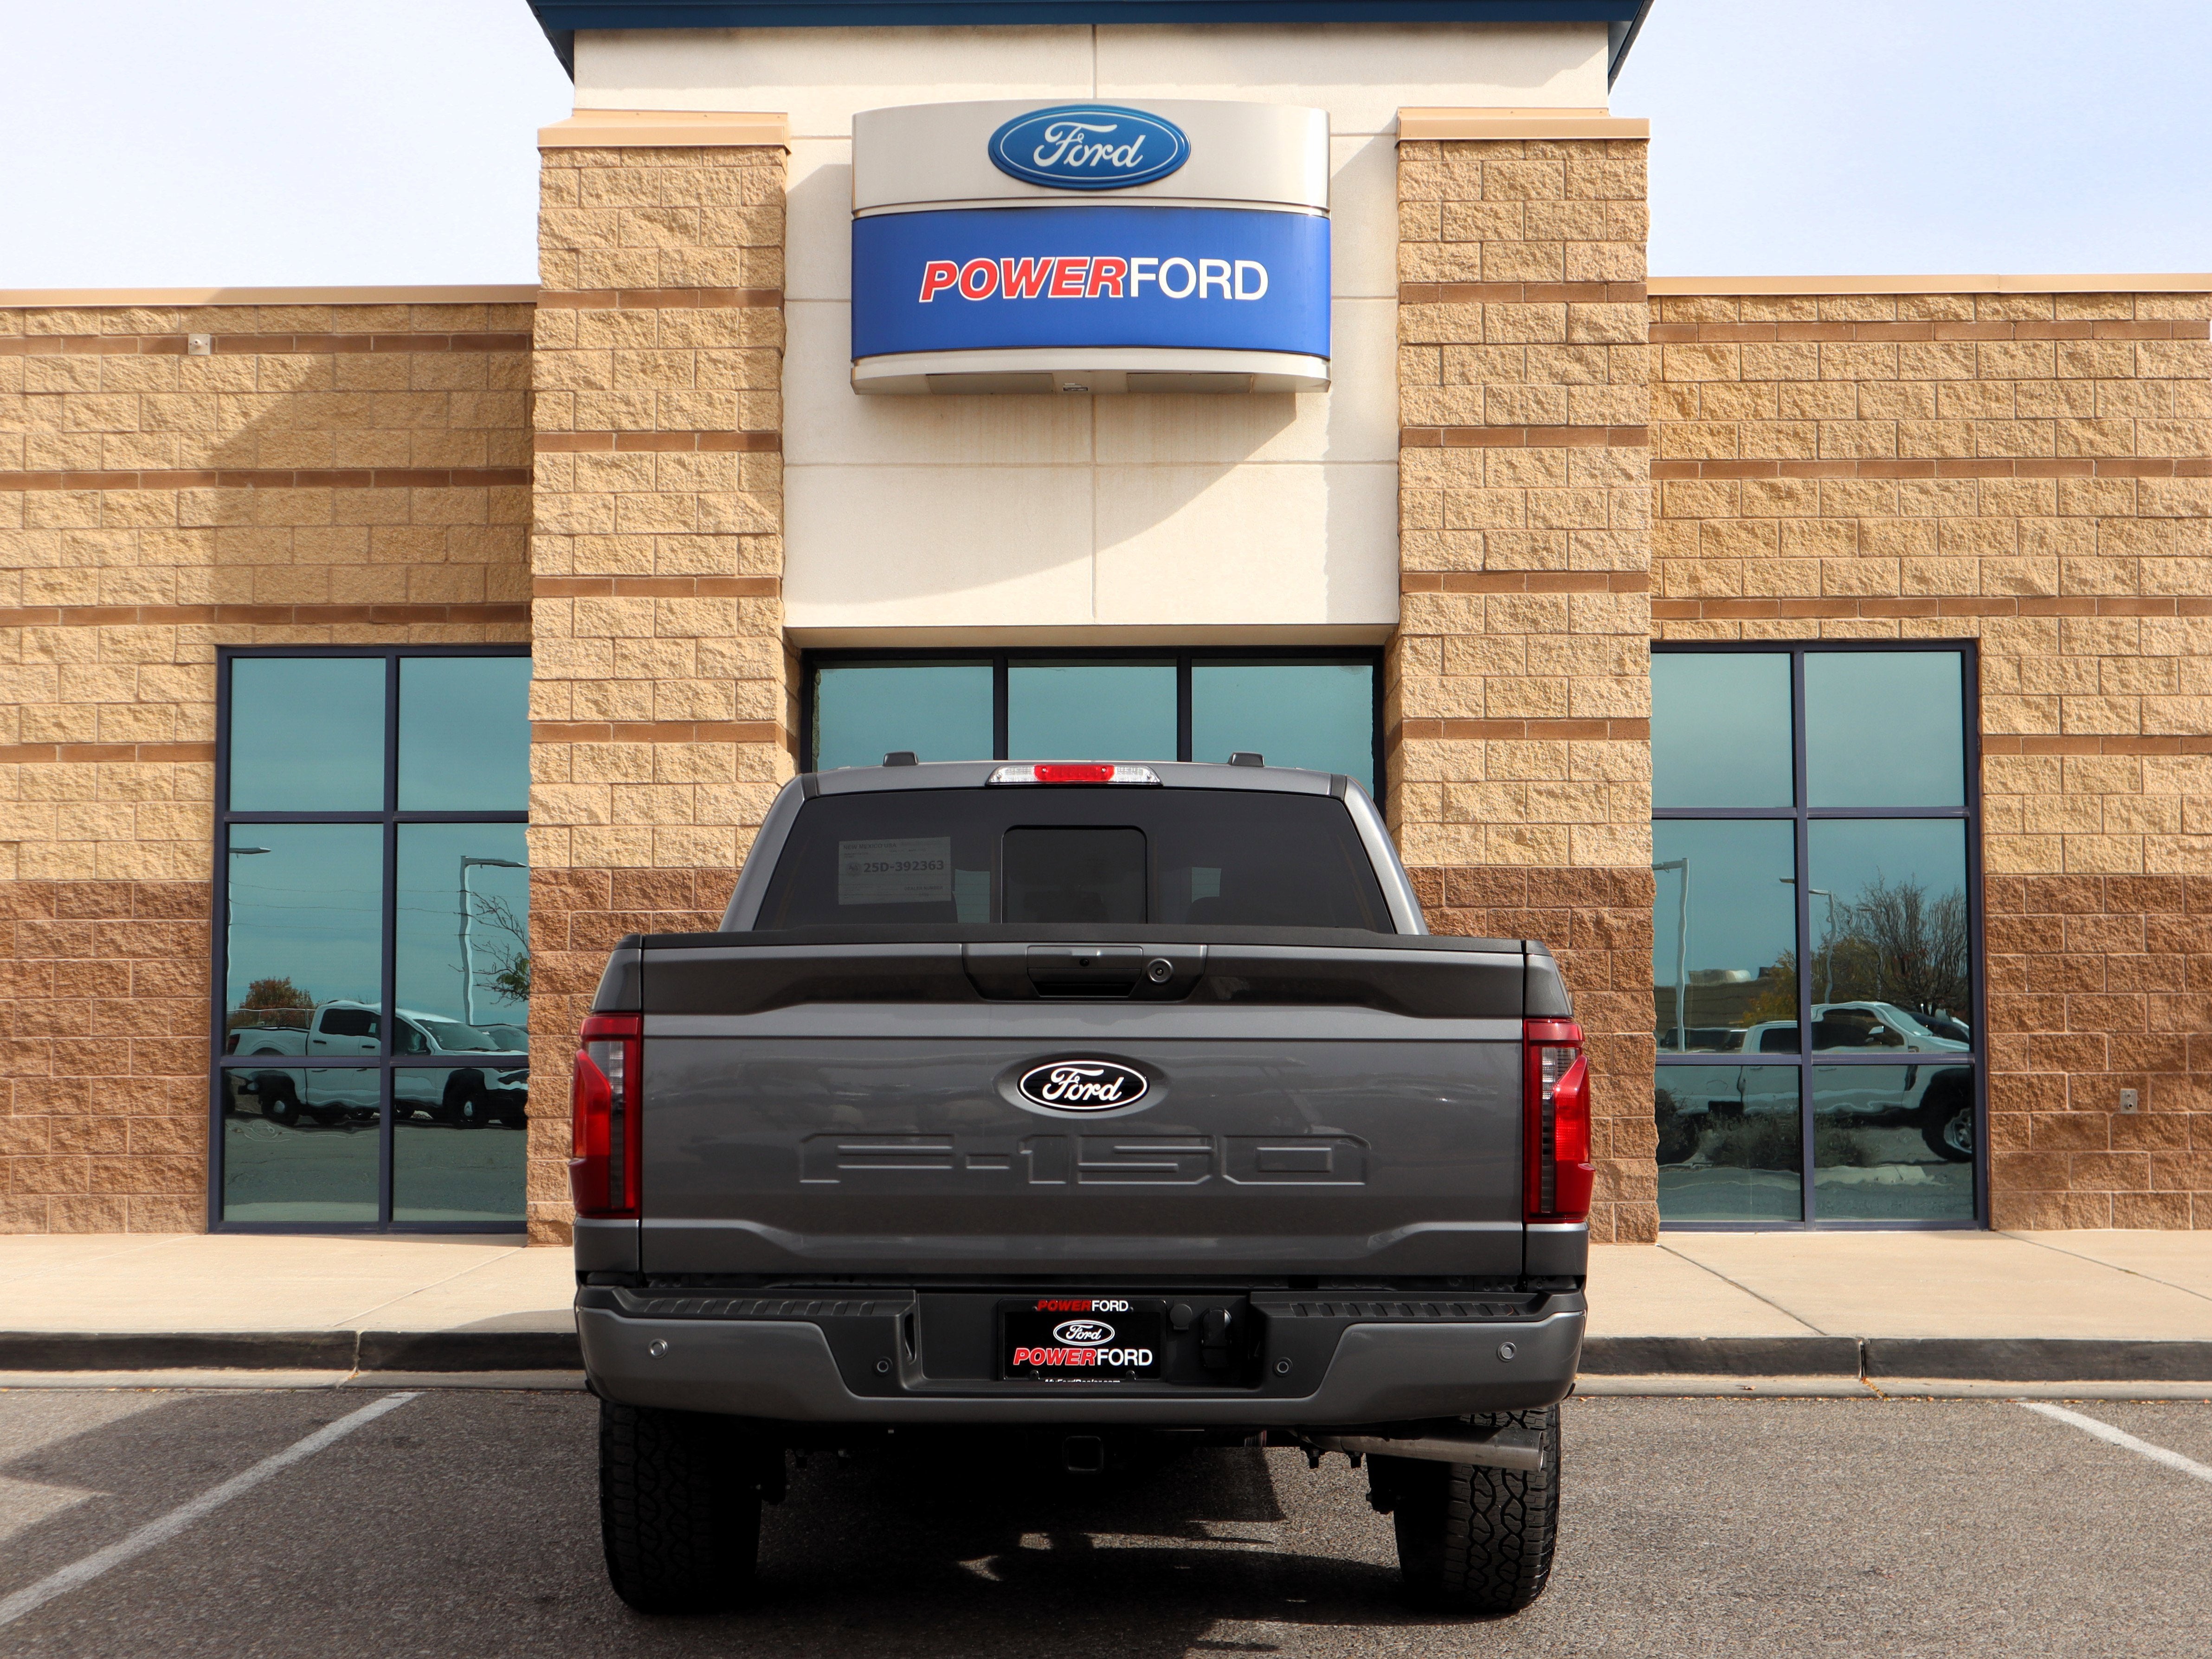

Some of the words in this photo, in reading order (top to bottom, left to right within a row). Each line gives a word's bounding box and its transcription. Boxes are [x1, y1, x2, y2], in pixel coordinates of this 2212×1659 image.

[1033, 121, 1146, 168] Ford
[919, 256, 1269, 303] POWERFORD
[864, 860, 944, 873] 25D-392363
[1042, 1067, 1124, 1101] Ford
[798, 1133, 1372, 1186] F-150
[1037, 1299, 1129, 1312] POWERFORD
[1065, 1324, 1103, 1340] Ford
[1013, 1347, 1153, 1366] POWERFORD
